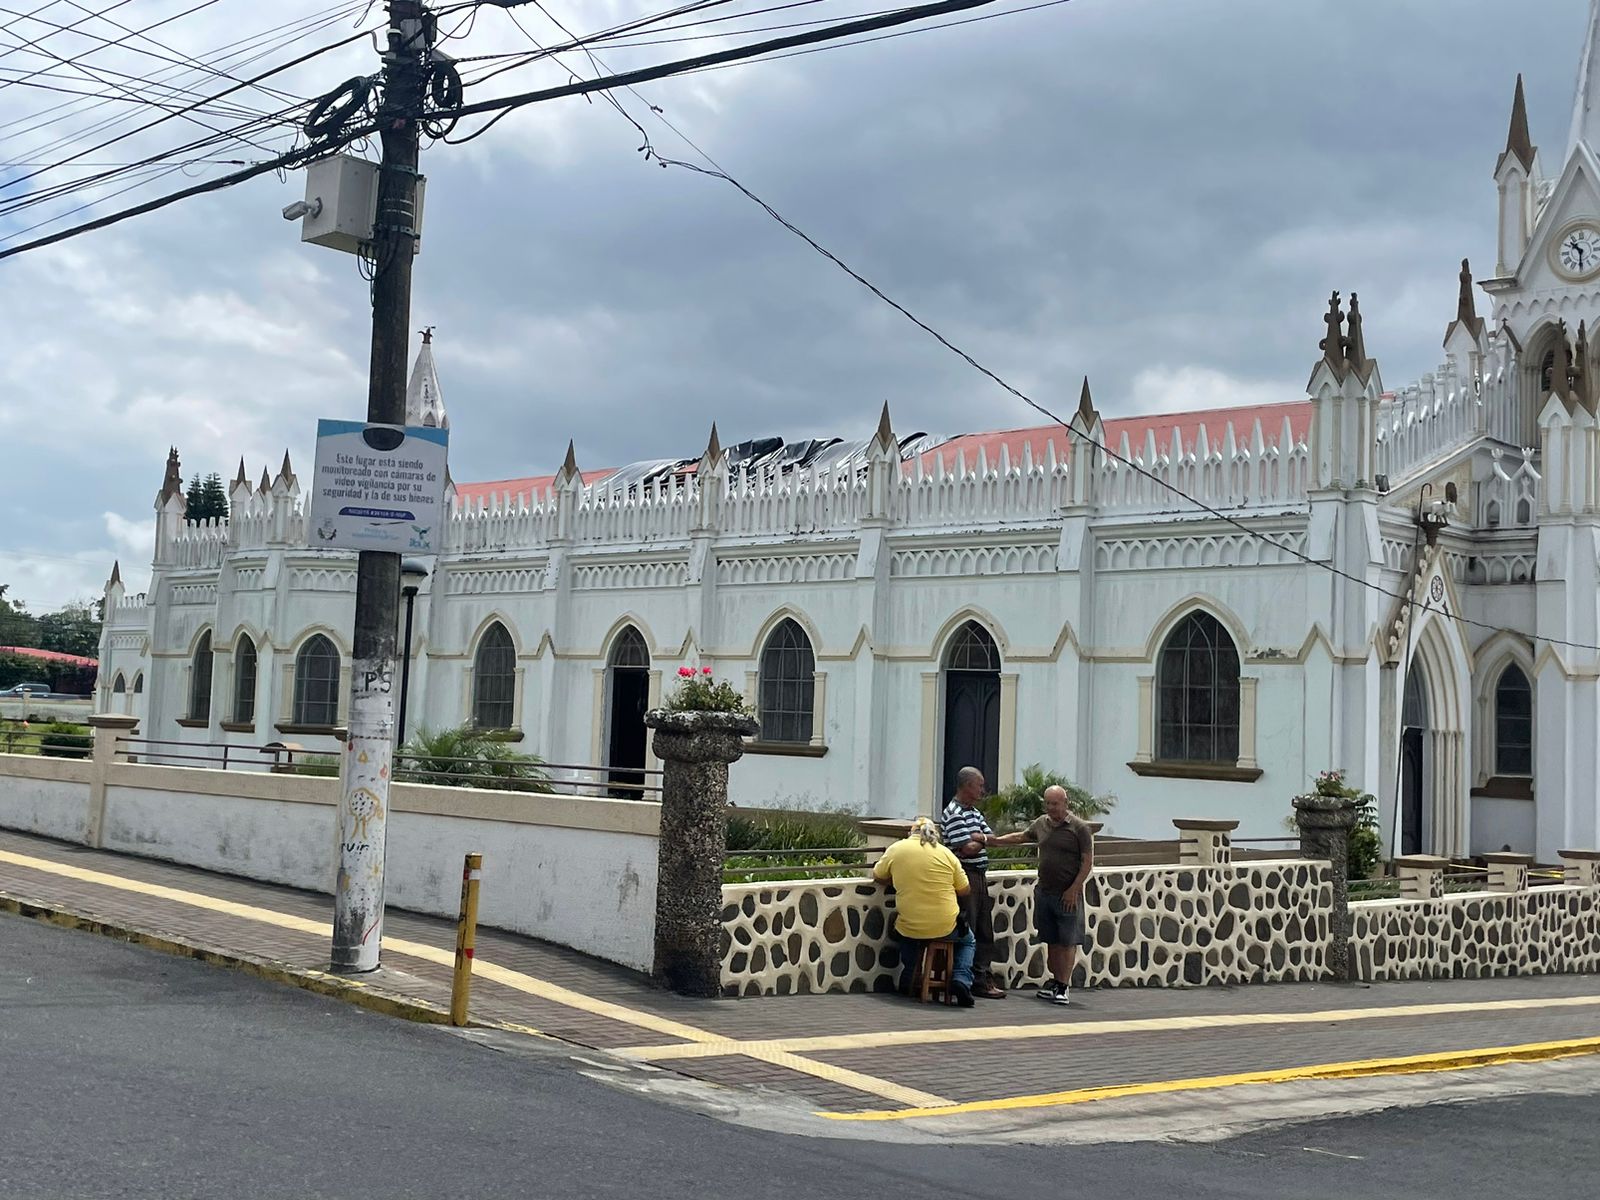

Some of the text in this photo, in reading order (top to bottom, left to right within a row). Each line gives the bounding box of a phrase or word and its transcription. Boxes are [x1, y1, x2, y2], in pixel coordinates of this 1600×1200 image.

[336, 453, 353, 464] Este
[356, 455, 376, 468] lugar
[398, 459, 423, 470] siendo
[321, 465, 372, 477] monitoreado
[374, 469, 388, 478] con
[426, 472, 436, 482] de
[357, 478, 395, 490] vigilancia
[397, 483, 410, 492] por
[413, 484, 422, 492] su
[322, 487, 434, 504] seguridad y la de sus bienes
